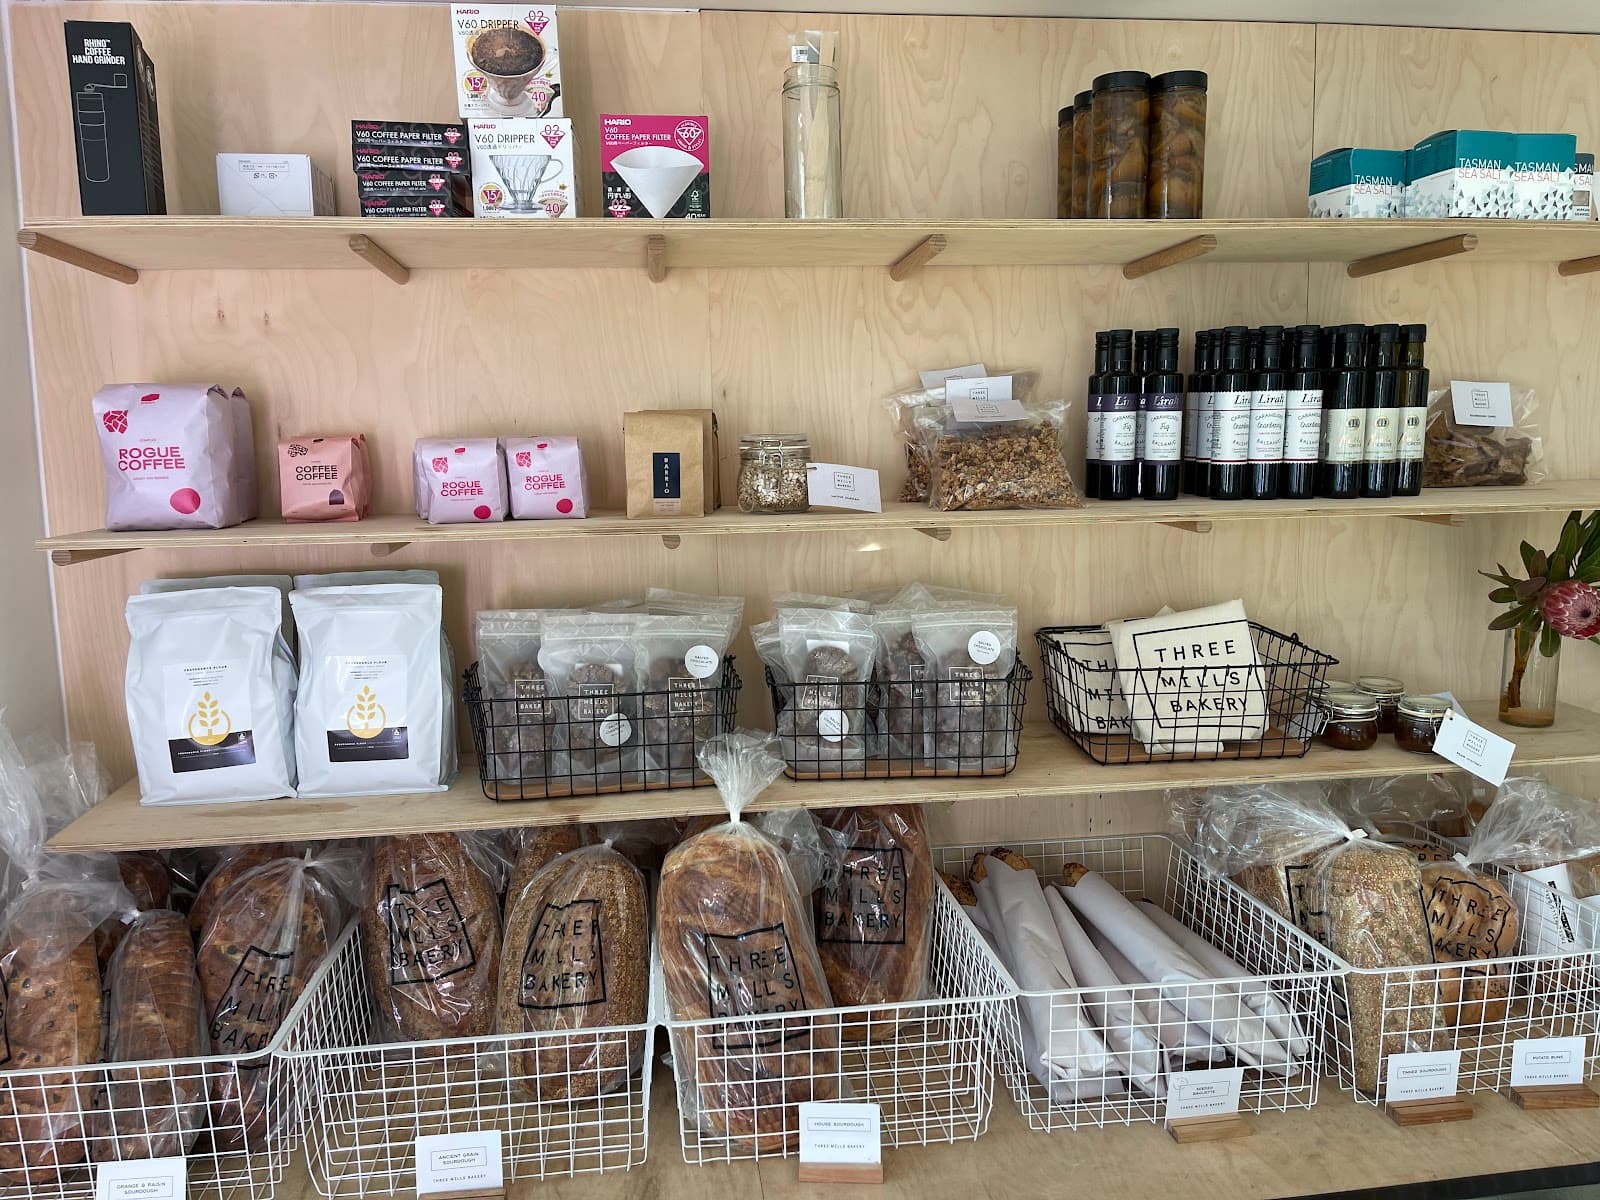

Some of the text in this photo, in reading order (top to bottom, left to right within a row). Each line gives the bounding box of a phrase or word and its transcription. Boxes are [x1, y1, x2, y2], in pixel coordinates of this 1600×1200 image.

[528, 10, 544, 22] 02
[457, 19, 519, 29] V60 DRIPPER
[84, 48, 112, 56] COFFEE
[72, 54, 126, 65] HAND GRINDER
[470, 77, 481, 87] 15
[531, 91, 546, 102] 40
[604, 118, 632, 126] HARIO
[544, 124, 560, 136] 02
[371, 131, 399, 139] COFFEE
[400, 132, 421, 140] PAPER
[422, 133, 442, 141] FILTER
[474, 133, 536, 144] V60 DRIPPER
[356, 155, 371, 163] V60
[372, 156, 399, 164] COFFEE
[400, 157, 422, 165] PAPER
[1459, 158, 1501, 170] TASMAN
[1514, 162, 1560, 173] TASMAN
[1354, 174, 1393, 186] TASMAN
[1457, 170, 1502, 180] SEA SALT
[1513, 172, 1561, 182] SEA SALT
[486, 190, 497, 200] 15
[1354, 185, 1394, 195] SEA SALT
[376, 206, 396, 214] COFFEE
[396, 206, 412, 214] PAPER
[545, 203, 560, 214] 40
[1257, 394, 1285, 404] Lirah
[119, 446, 181, 460] ROGUE
[118, 458, 186, 472] COFFEE
[295, 465, 338, 473] COFFEE
[296, 472, 338, 481] COFFEE
[525, 474, 564, 483] ROGUE
[441, 480, 481, 489] ROGUE
[524, 481, 567, 491] COFFEE
[440, 488, 485, 497] COFFEE
[1154, 639, 1236, 663] THREE
[1161, 671, 1241, 688] MILLS
[1169, 697, 1247, 713] BAKERY
[1095, 716, 1131, 729] BAK
[826, 887, 901, 905] MILLS
[1438, 888, 1504, 922] THREE
[824, 911, 901, 929] BAKERY
[1431, 909, 1496, 944] MILLS
[1434, 937, 1493, 961] AKERY
[711, 946, 787, 973] THREE
[524, 969, 598, 992] BAKERY
[211, 1021, 272, 1052] BAKE
[438, 1152, 461, 1160] ANCIENT
